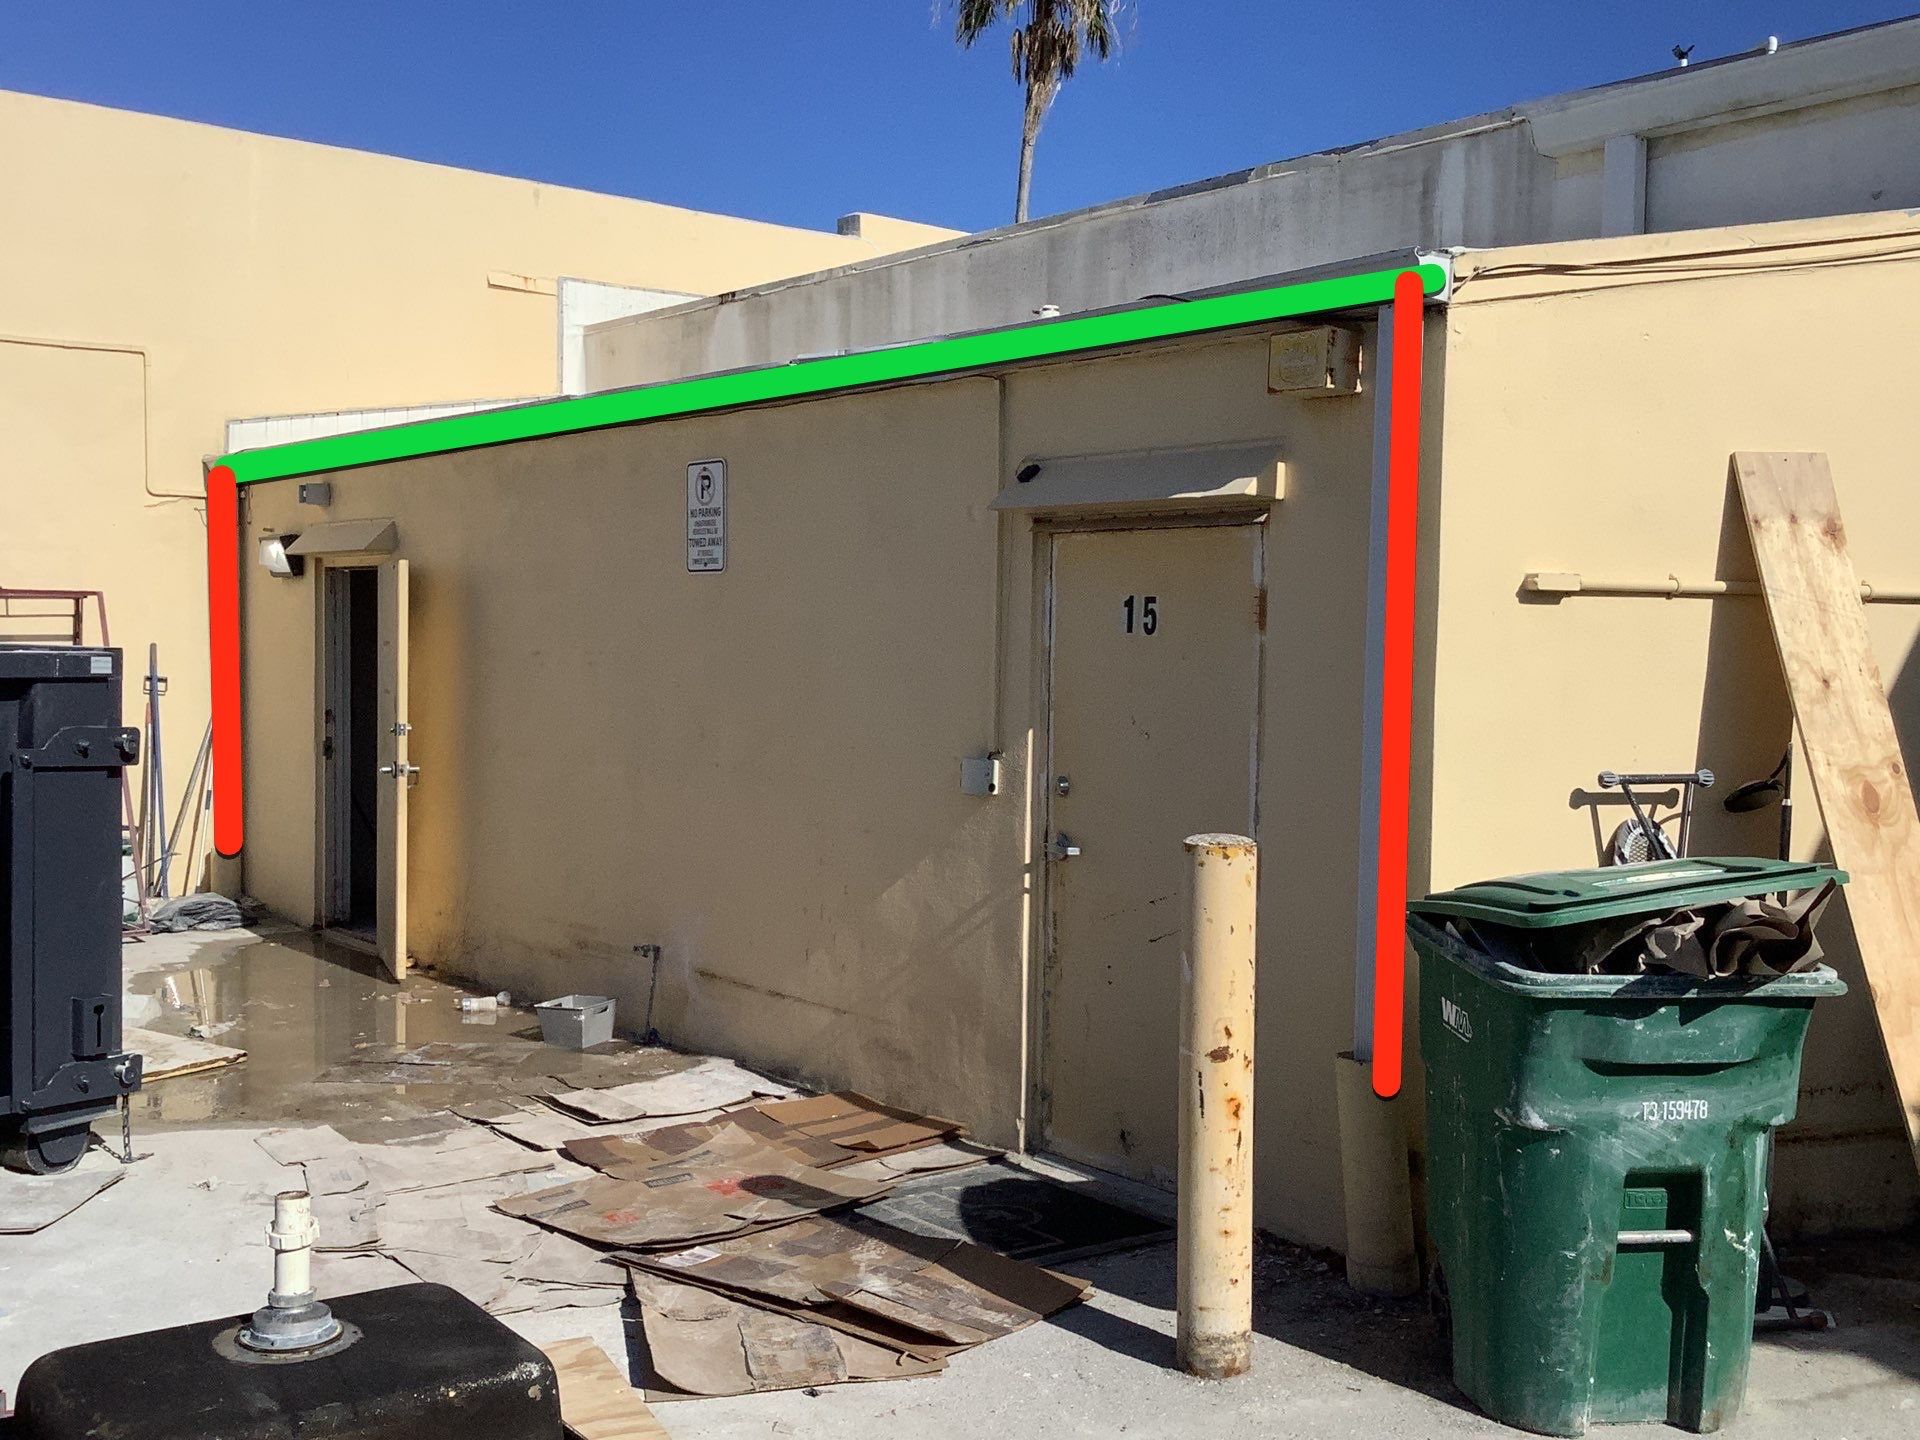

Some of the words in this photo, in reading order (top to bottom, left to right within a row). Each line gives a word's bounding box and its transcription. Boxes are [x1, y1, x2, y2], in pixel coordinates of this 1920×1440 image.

[690, 508, 698, 518] NO
[699, 506, 721, 517] PARKING
[689, 537, 706, 547] TOWED
[708, 536, 722, 547] AWAY
[1124, 595, 1157, 635] 15
[1663, 1099, 1708, 1120] 159478
